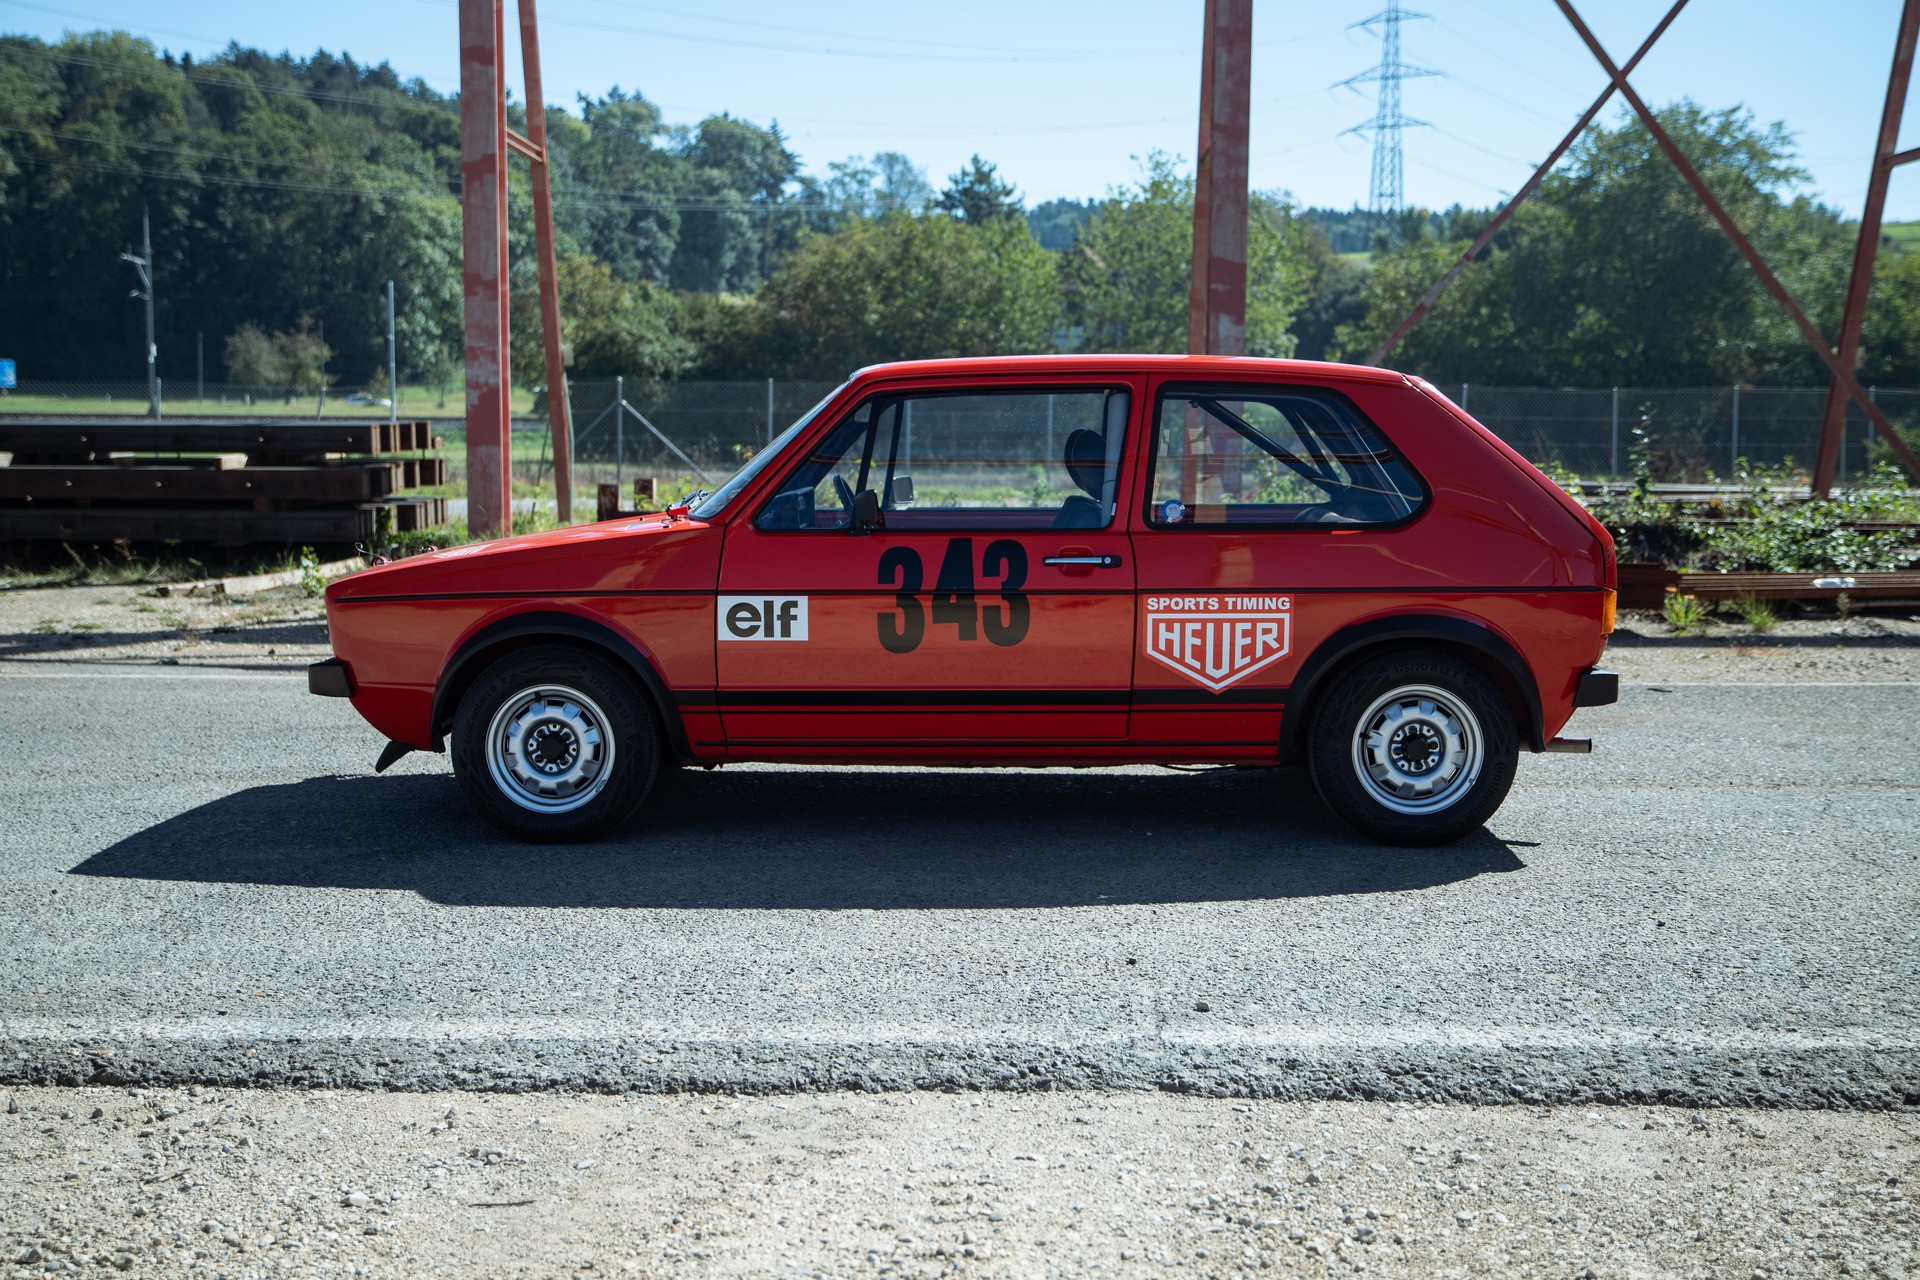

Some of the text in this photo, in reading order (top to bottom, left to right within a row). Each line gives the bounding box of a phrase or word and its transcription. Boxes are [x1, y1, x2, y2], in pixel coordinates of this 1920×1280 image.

[877, 538, 1031, 654] 343
[1147, 597, 1290, 611] SPORTS TIMING
[726, 600, 799, 638] elf
[1158, 622, 1280, 679] HEUER
[1394, 662, 1429, 674] 175/70
